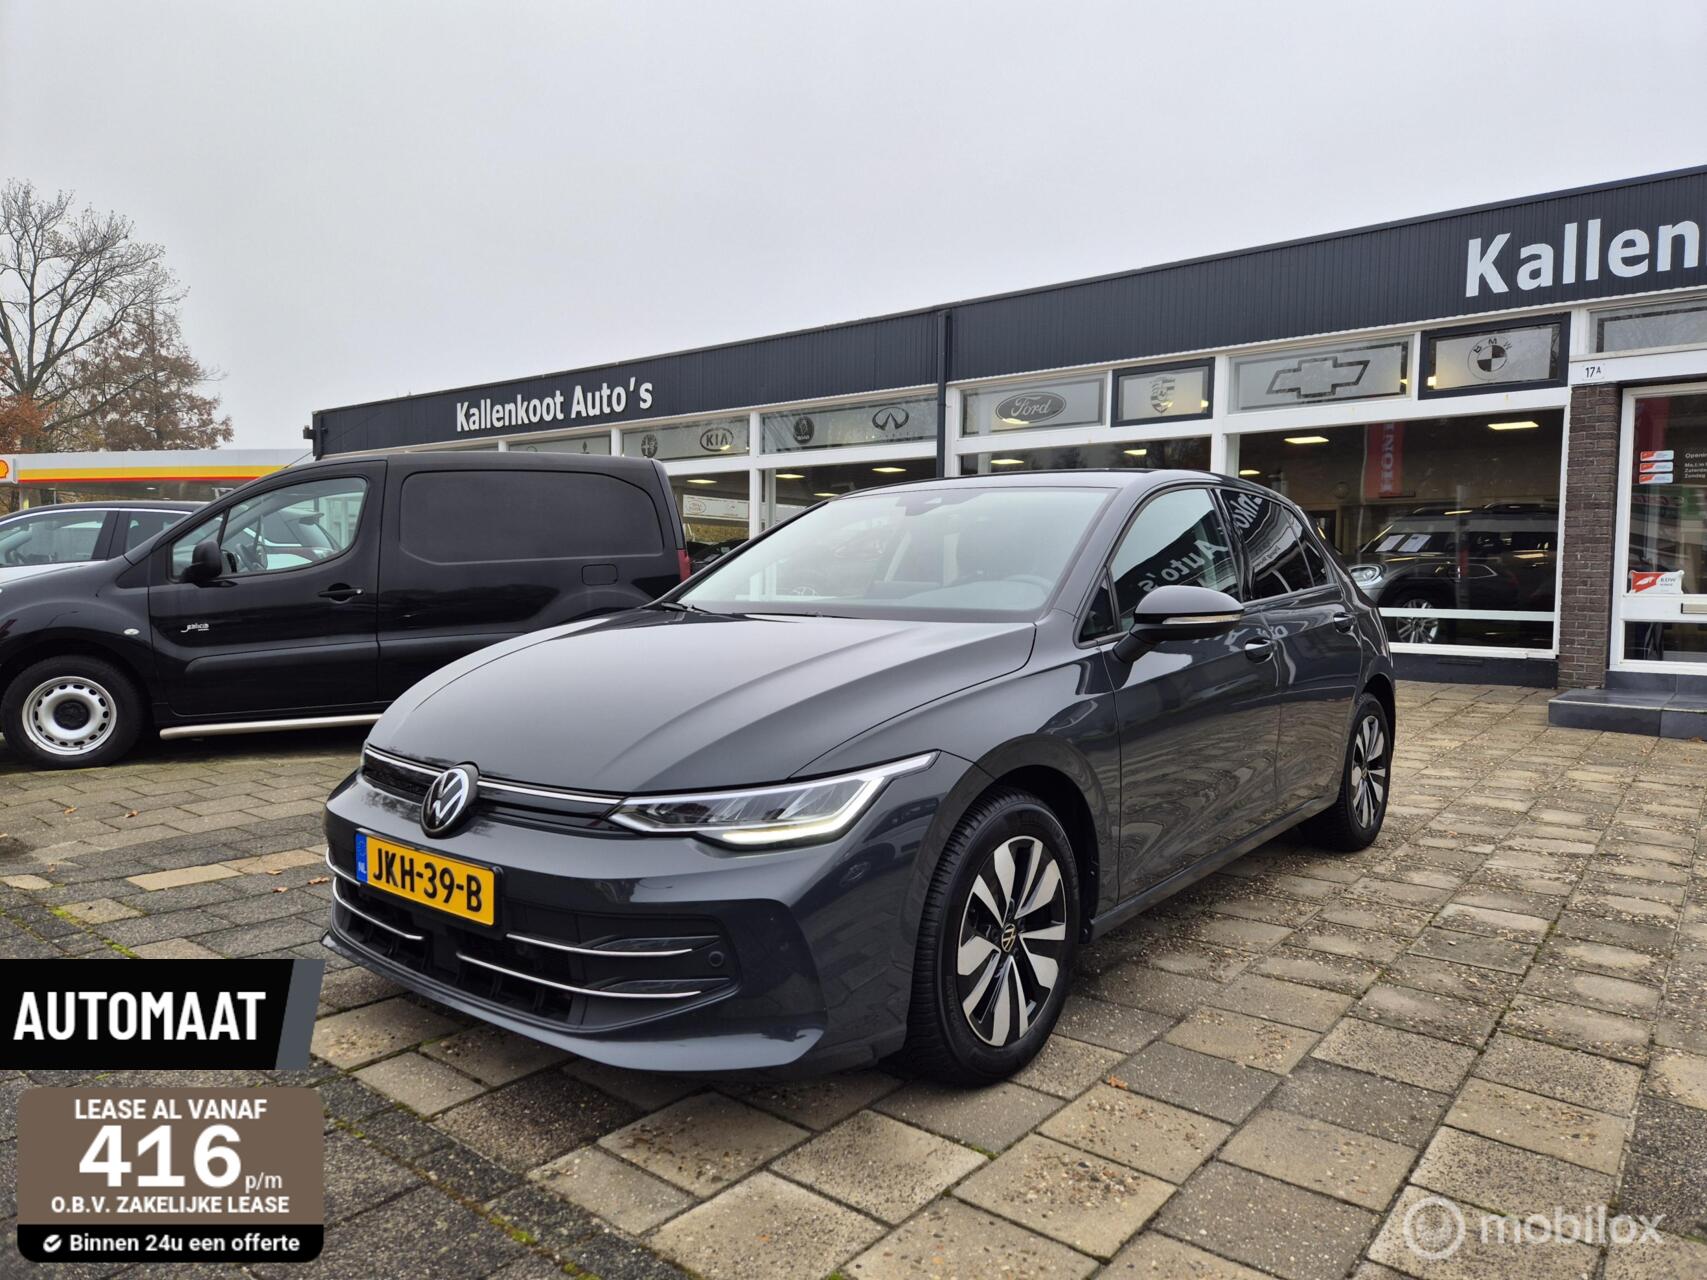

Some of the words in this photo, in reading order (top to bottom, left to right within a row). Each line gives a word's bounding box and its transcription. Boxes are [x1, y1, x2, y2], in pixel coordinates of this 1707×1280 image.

[1465, 219, 1707, 298] Kallen
[456, 391, 564, 432] Kallenkoot
[571, 377, 653, 419] Auto's
[1010, 396, 1052, 416] Ford
[705, 434, 729, 447] KIA
[373, 847, 482, 913] JKH-39-B
